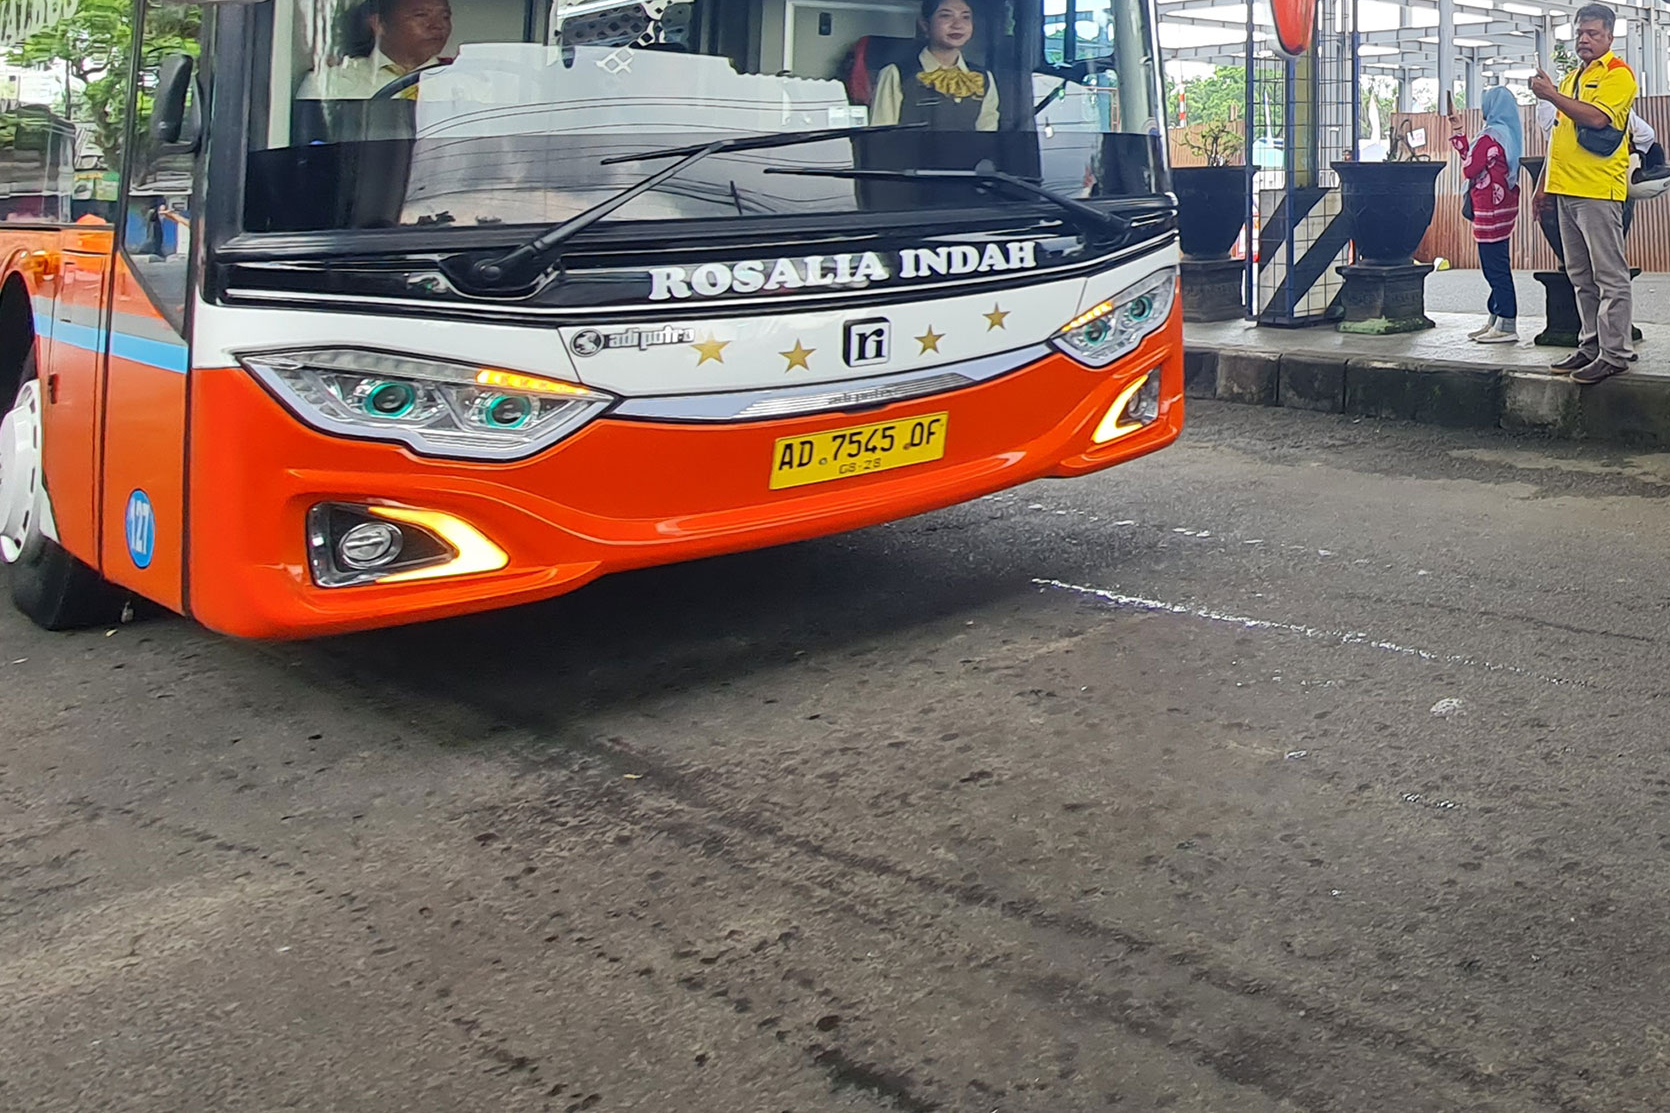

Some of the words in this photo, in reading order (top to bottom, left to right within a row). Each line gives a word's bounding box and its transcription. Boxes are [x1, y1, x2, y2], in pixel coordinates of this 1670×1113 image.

[648, 251, 890, 301] ROSALIA
[898, 240, 1037, 280] INDAH
[778, 440, 814, 471] AD
[832, 426, 896, 461] 7545
[130, 496, 151, 555] 127
